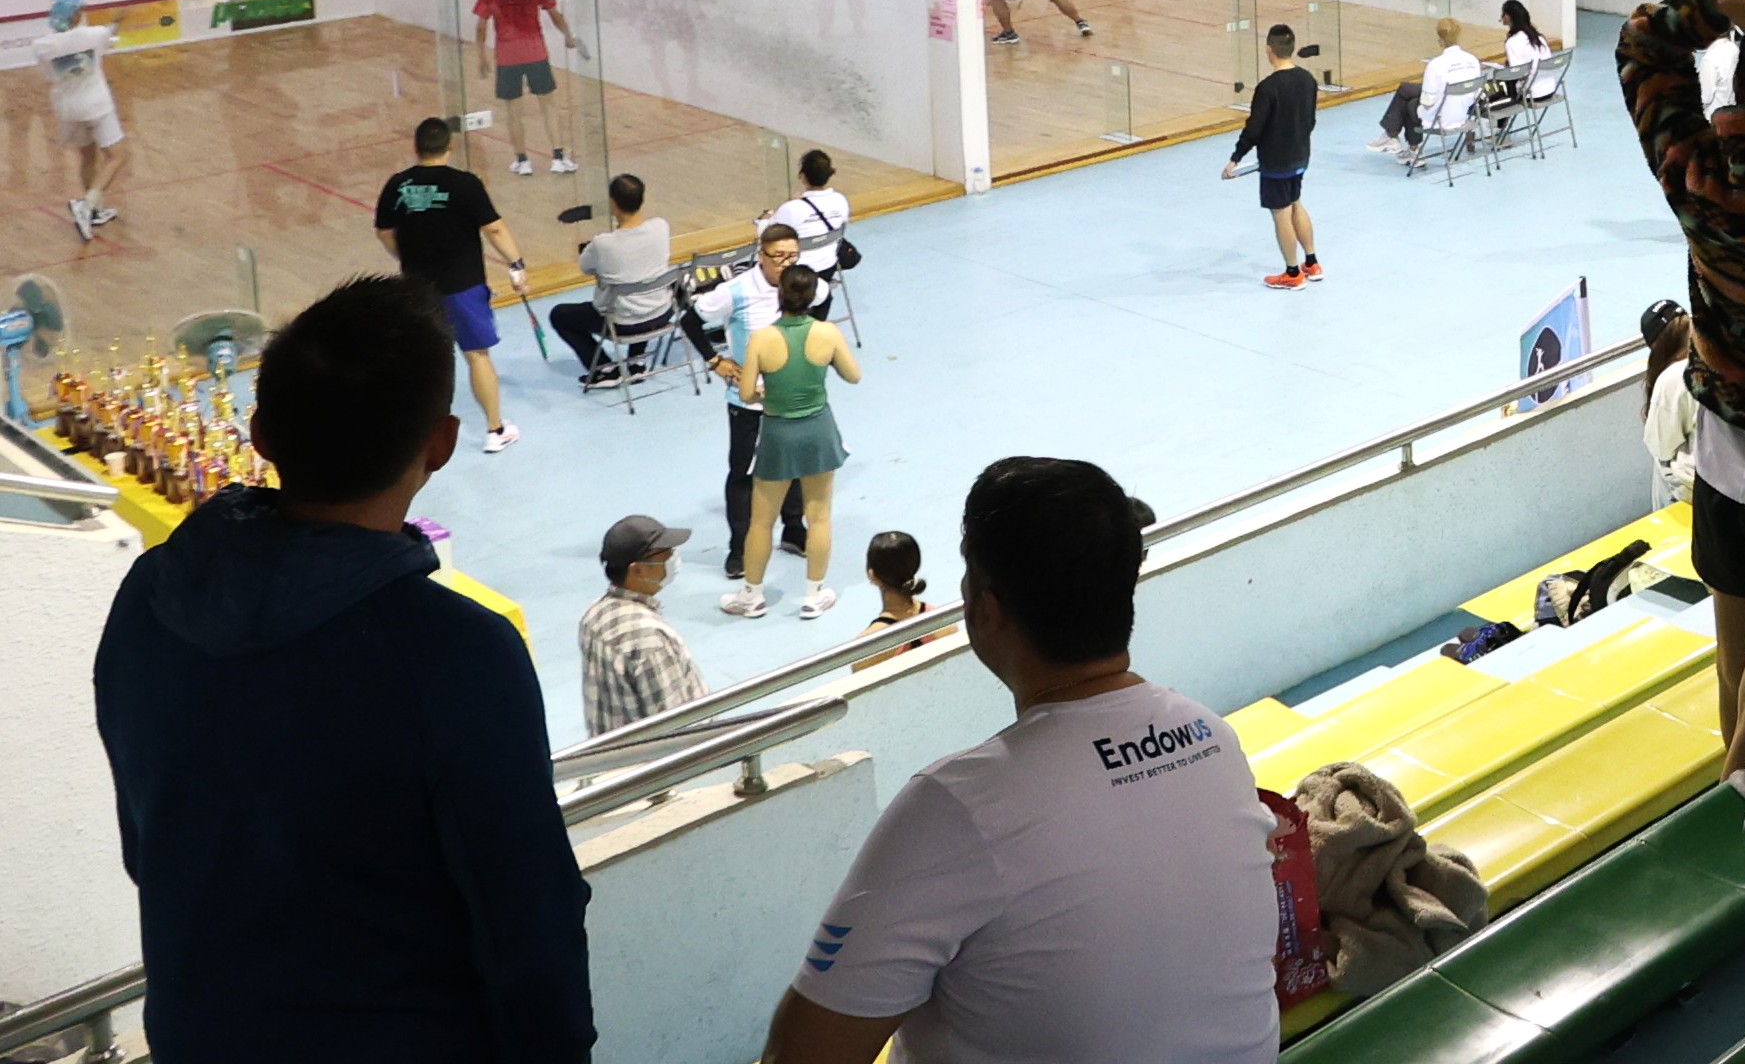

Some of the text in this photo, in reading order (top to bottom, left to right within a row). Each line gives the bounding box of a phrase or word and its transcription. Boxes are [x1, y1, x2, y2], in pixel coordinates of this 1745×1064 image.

[1111, 772, 1144, 787] INVEST
[1146, 763, 1177, 778] BETTER
[1177, 758, 1188, 768] TO
